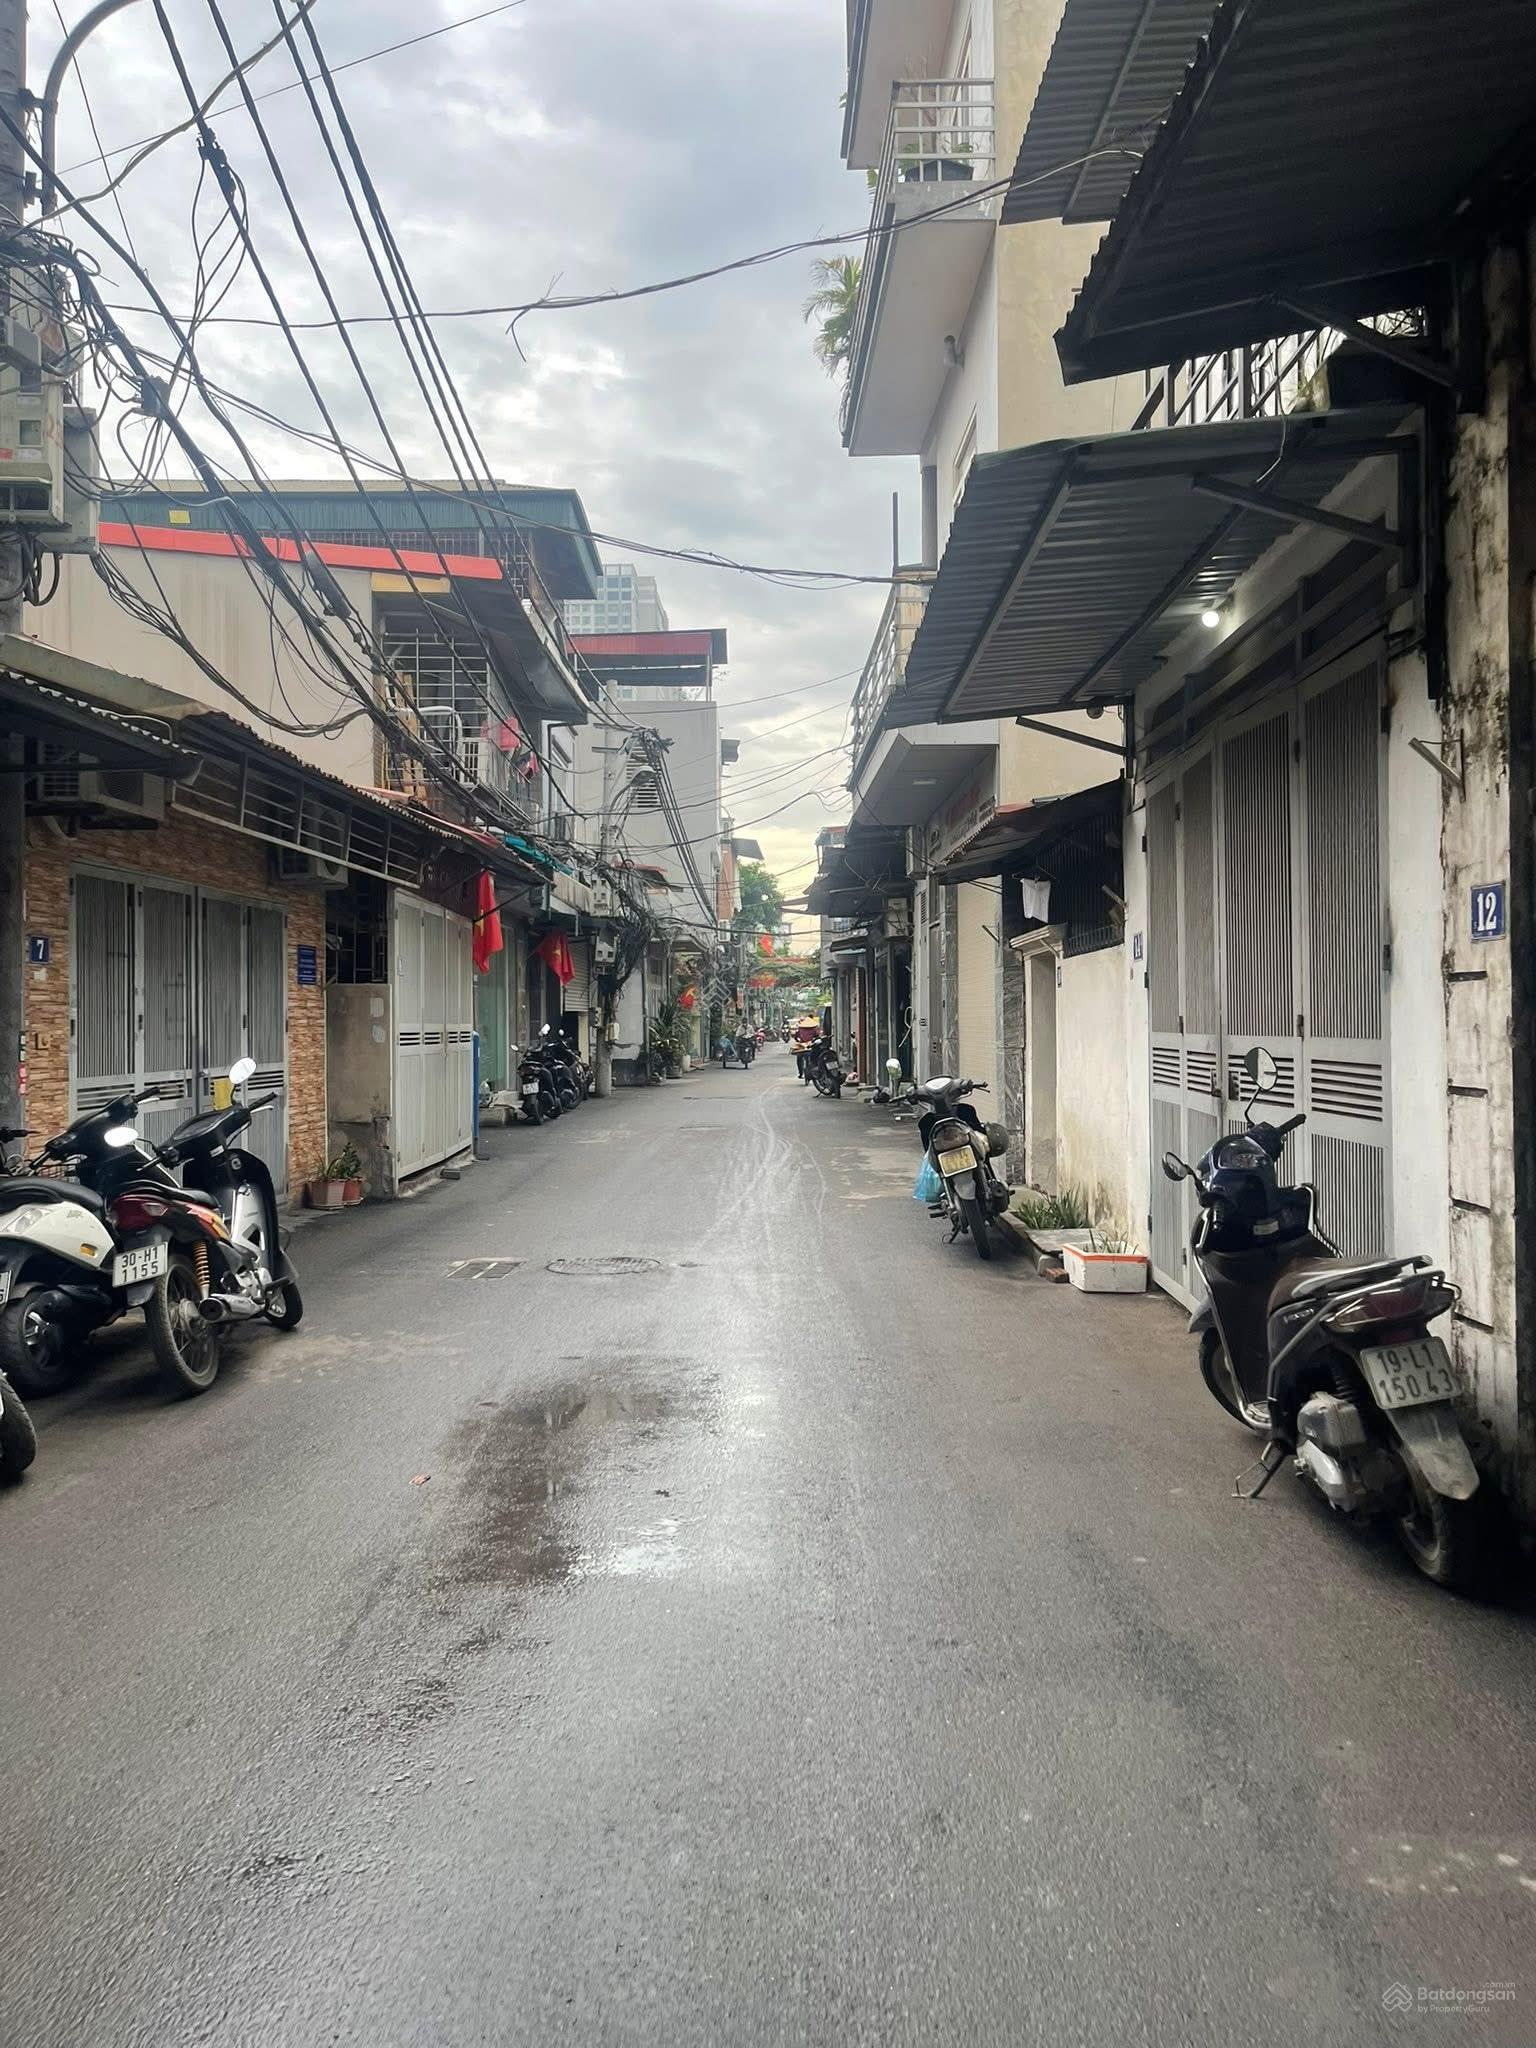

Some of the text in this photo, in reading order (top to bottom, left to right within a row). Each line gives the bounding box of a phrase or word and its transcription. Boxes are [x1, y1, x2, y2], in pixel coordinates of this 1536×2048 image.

[1477, 892, 1497, 931] 12
[37, 940, 44, 959] 7
[122, 1247, 158, 1268] 30-H1
[122, 1261, 158, 1283] 1155
